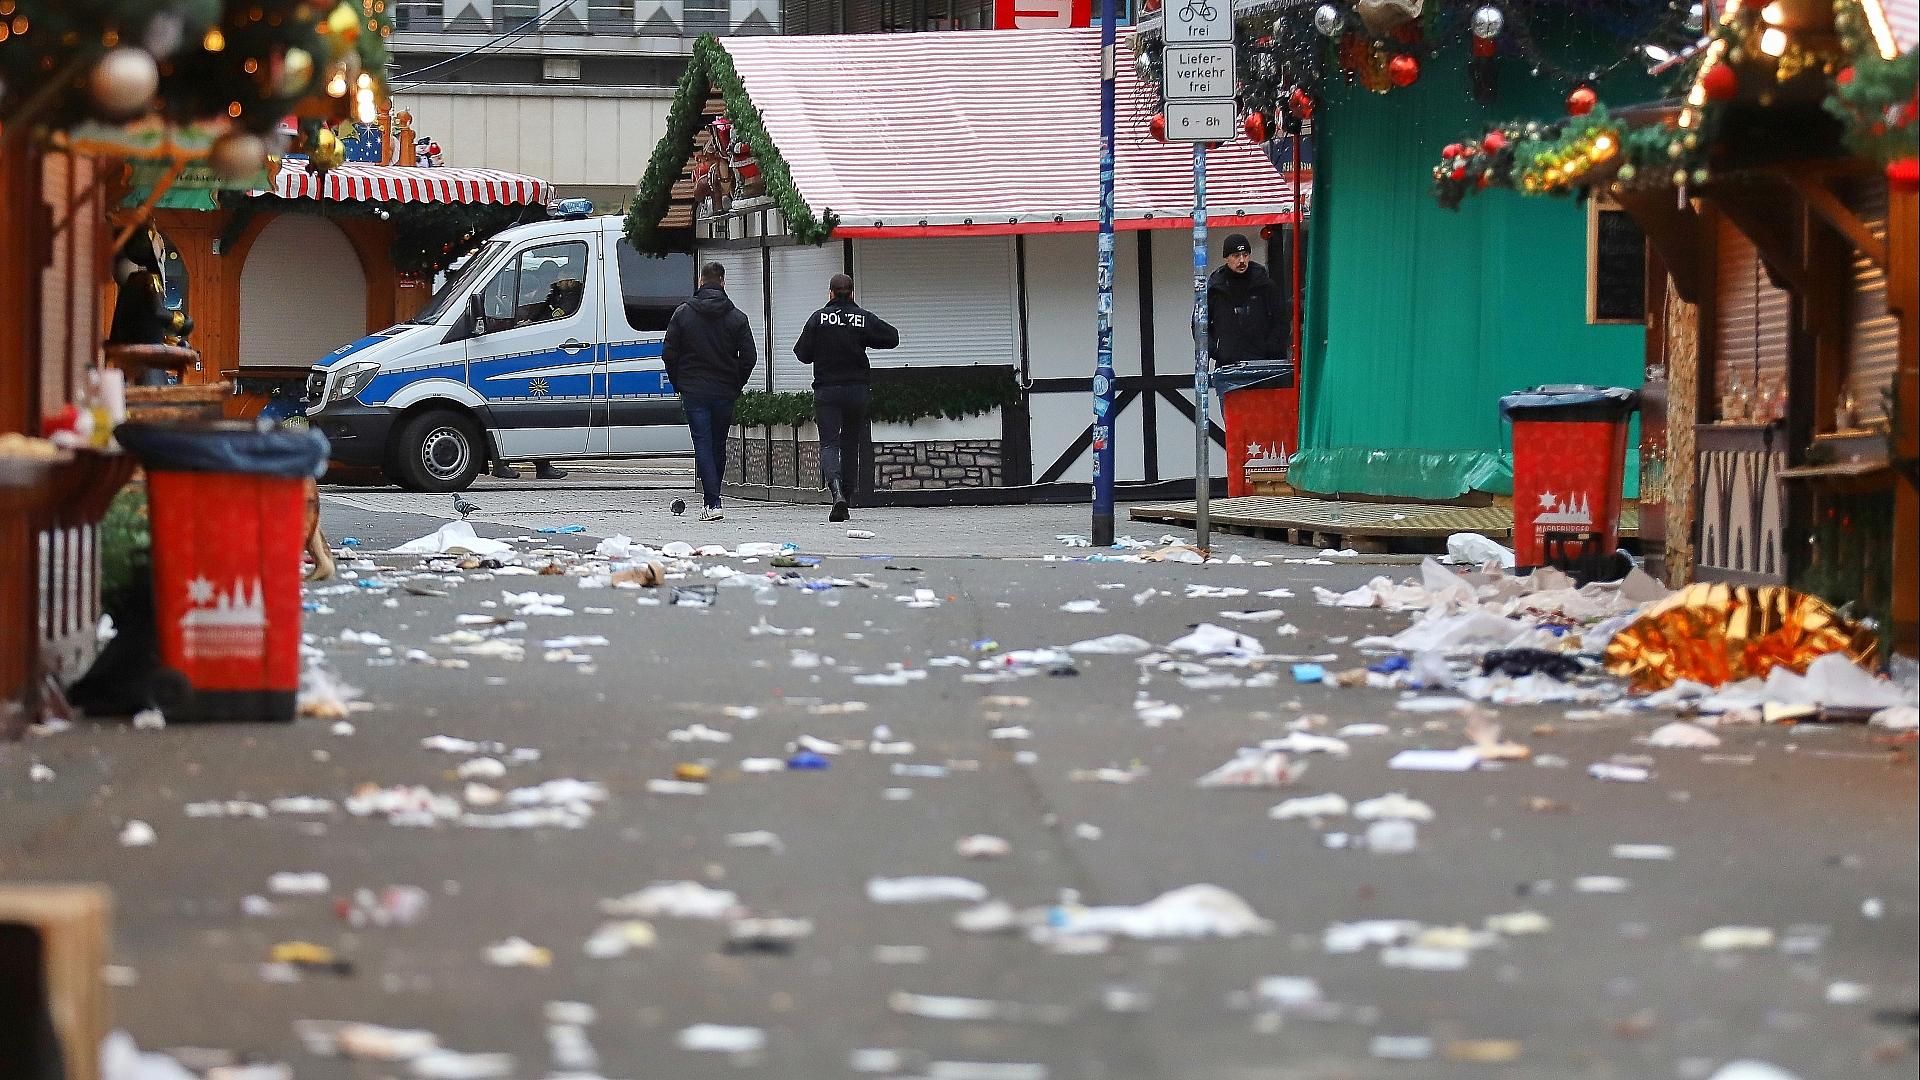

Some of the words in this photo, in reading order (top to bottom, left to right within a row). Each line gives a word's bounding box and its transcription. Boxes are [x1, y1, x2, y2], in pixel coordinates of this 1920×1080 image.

[1188, 25, 1209, 36] frei
[1179, 53, 1222, 65] Liefer-
[1177, 66, 1225, 78] verkehr
[1189, 81, 1210, 92] frei
[1181, 117, 1189, 127] 6
[1205, 116, 1220, 126] 8h
[820, 310, 866, 328] POLZEI
